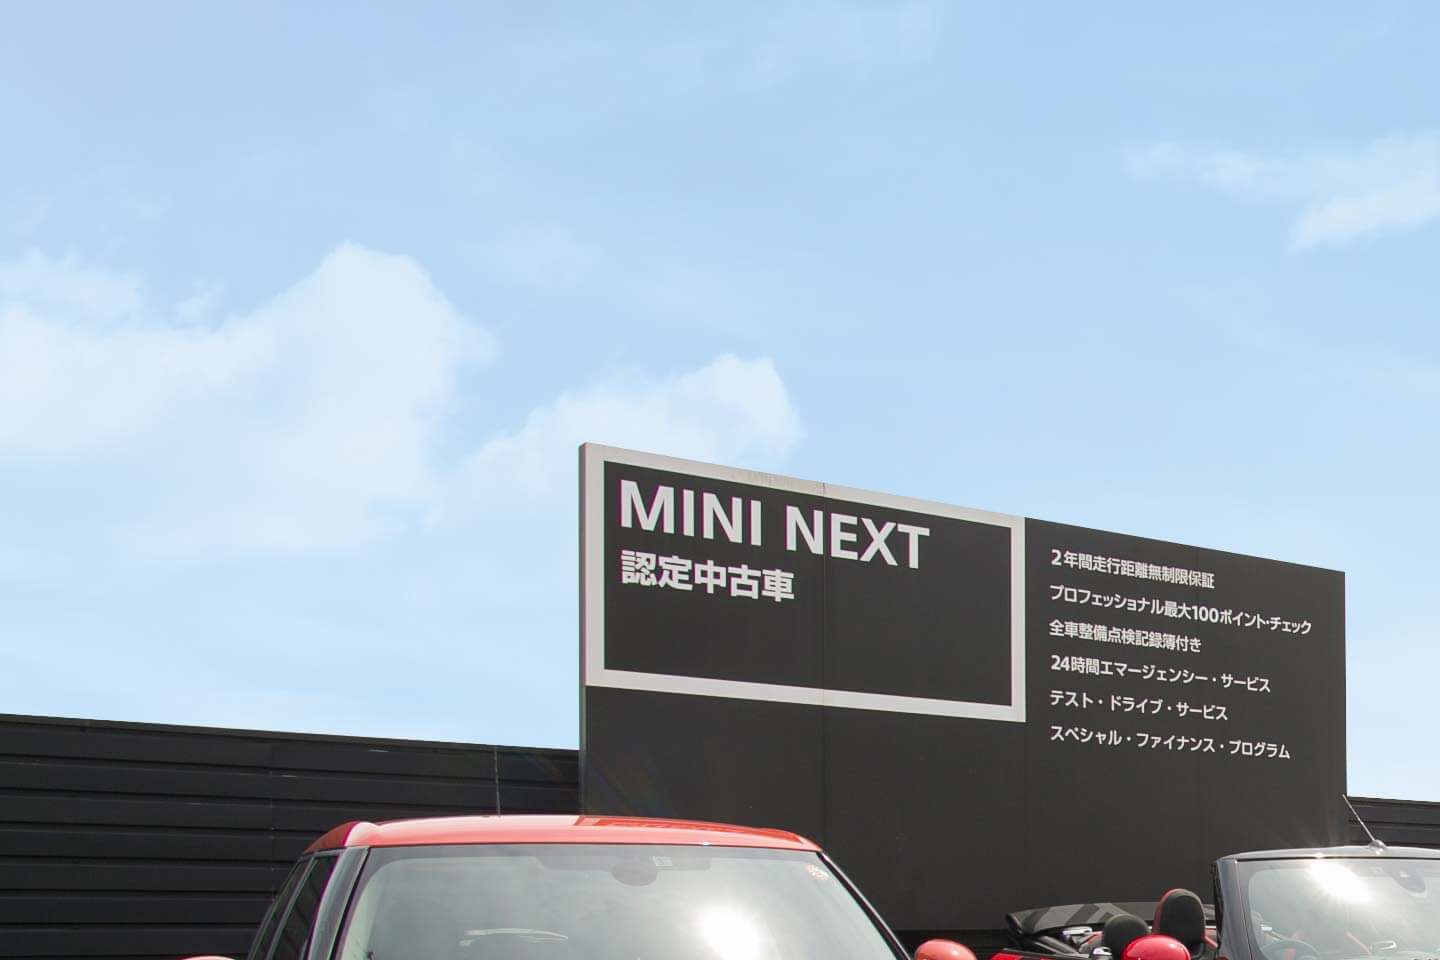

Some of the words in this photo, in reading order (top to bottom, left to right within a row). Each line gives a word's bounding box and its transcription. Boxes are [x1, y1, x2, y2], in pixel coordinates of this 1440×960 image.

[620, 479, 762, 546] MINI
[786, 505, 930, 569] NEXT
[620, 549, 795, 602] 認定中古車
[1051, 548, 1215, 589] 2年間走行距離無制限保証
[1048, 619, 1202, 653] 全車整備点検記録簿付き
